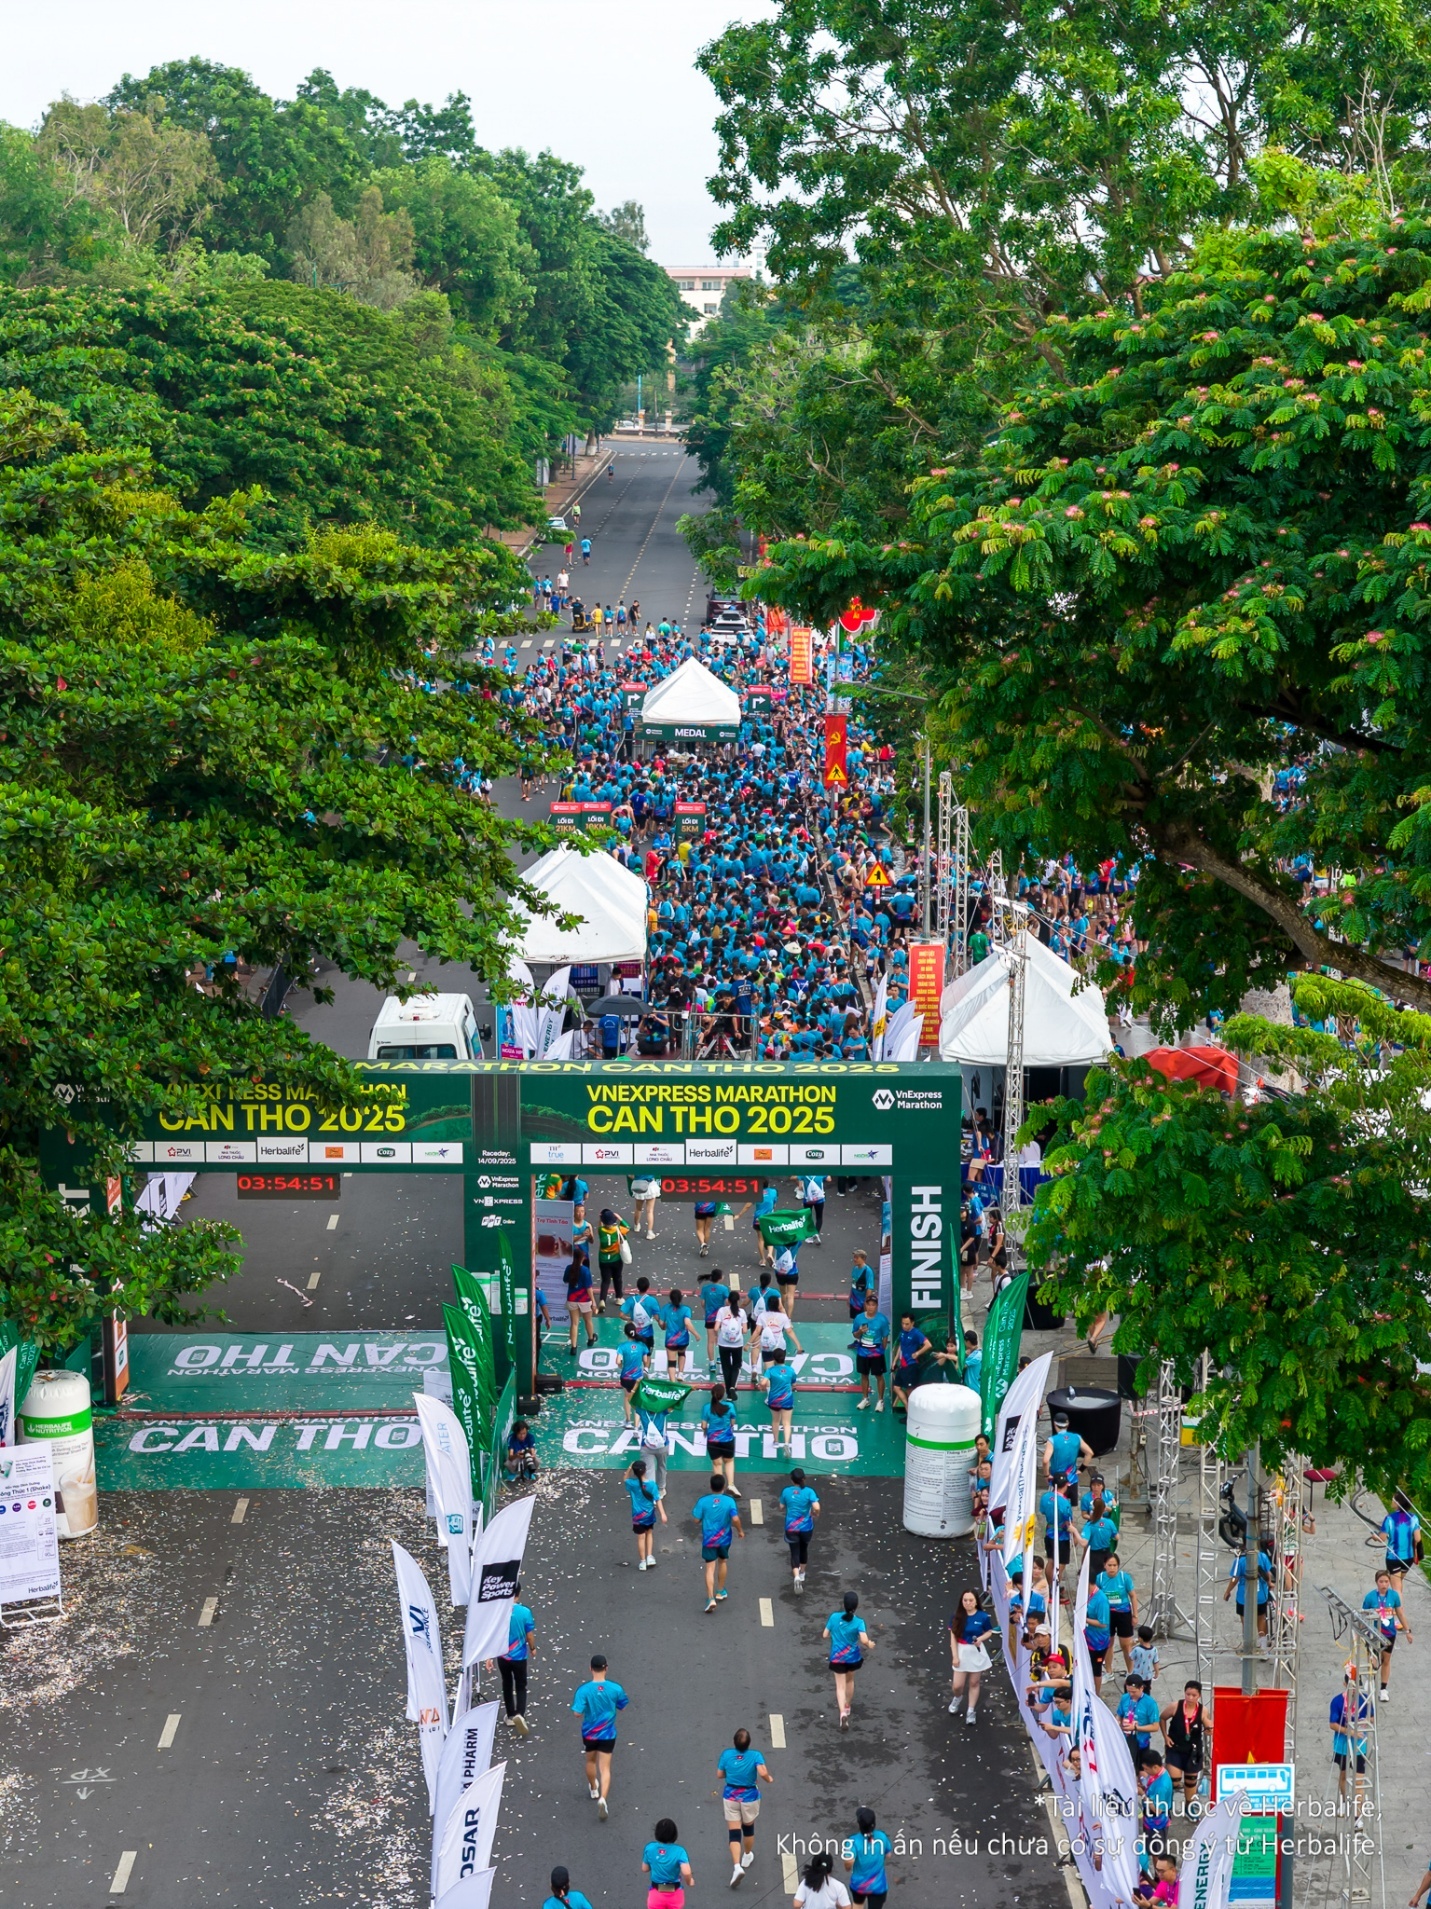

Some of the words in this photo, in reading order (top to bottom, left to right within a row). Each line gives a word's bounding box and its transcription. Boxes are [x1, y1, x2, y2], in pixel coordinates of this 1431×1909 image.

[675, 728, 707, 738] MEDAL
[681, 825, 699, 833] 5KM
[353, 1061, 592, 1072] MARATHON
[596, 1062, 692, 1073] CAN
[702, 1063, 785, 1073] THO
[794, 1063, 900, 1073] 2025
[286, 1083, 406, 1101] MAHON
[586, 1084, 711, 1102] VNEXPRESS
[715, 1084, 837, 1103] MARATHON
[896, 1090, 942, 1100] VnExpress
[897, 1100, 942, 1109] Marathon
[240, 1104, 311, 1131] THO
[318, 1104, 406, 1131] 2025
[587, 1105, 663, 1133] CAN
[669, 1105, 740, 1133] THO
[747, 1105, 835, 1134] 2025
[176, 1148, 191, 1156] PVI
[261, 1146, 300, 1155] Herbalife
[482, 1150, 511, 1158] Raceday:
[689, 1148, 729, 1157] Herbalife
[238, 1176, 334, 1191] 03:54:51
[661, 1179, 758, 1193] 03:54:51
[769, 1220, 803, 1233] Herbalife
[911, 1184, 943, 1309] FINISH
[173, 1343, 295, 1369] THO
[128, 1425, 279, 1453] CAN
[292, 1423, 423, 1451] THO
[436, 1422, 451, 1454] ATER
[481, 1581, 515, 1592] Power
[482, 1575, 504, 1585] Key
[28, 1582, 56, 1594] Herbalife
[480, 1587, 513, 1600] Sports
[409, 1604, 425, 1639] VI
[463, 1727, 478, 1778] PHARM
[1194, 1843, 1211, 1909] ENERGY
